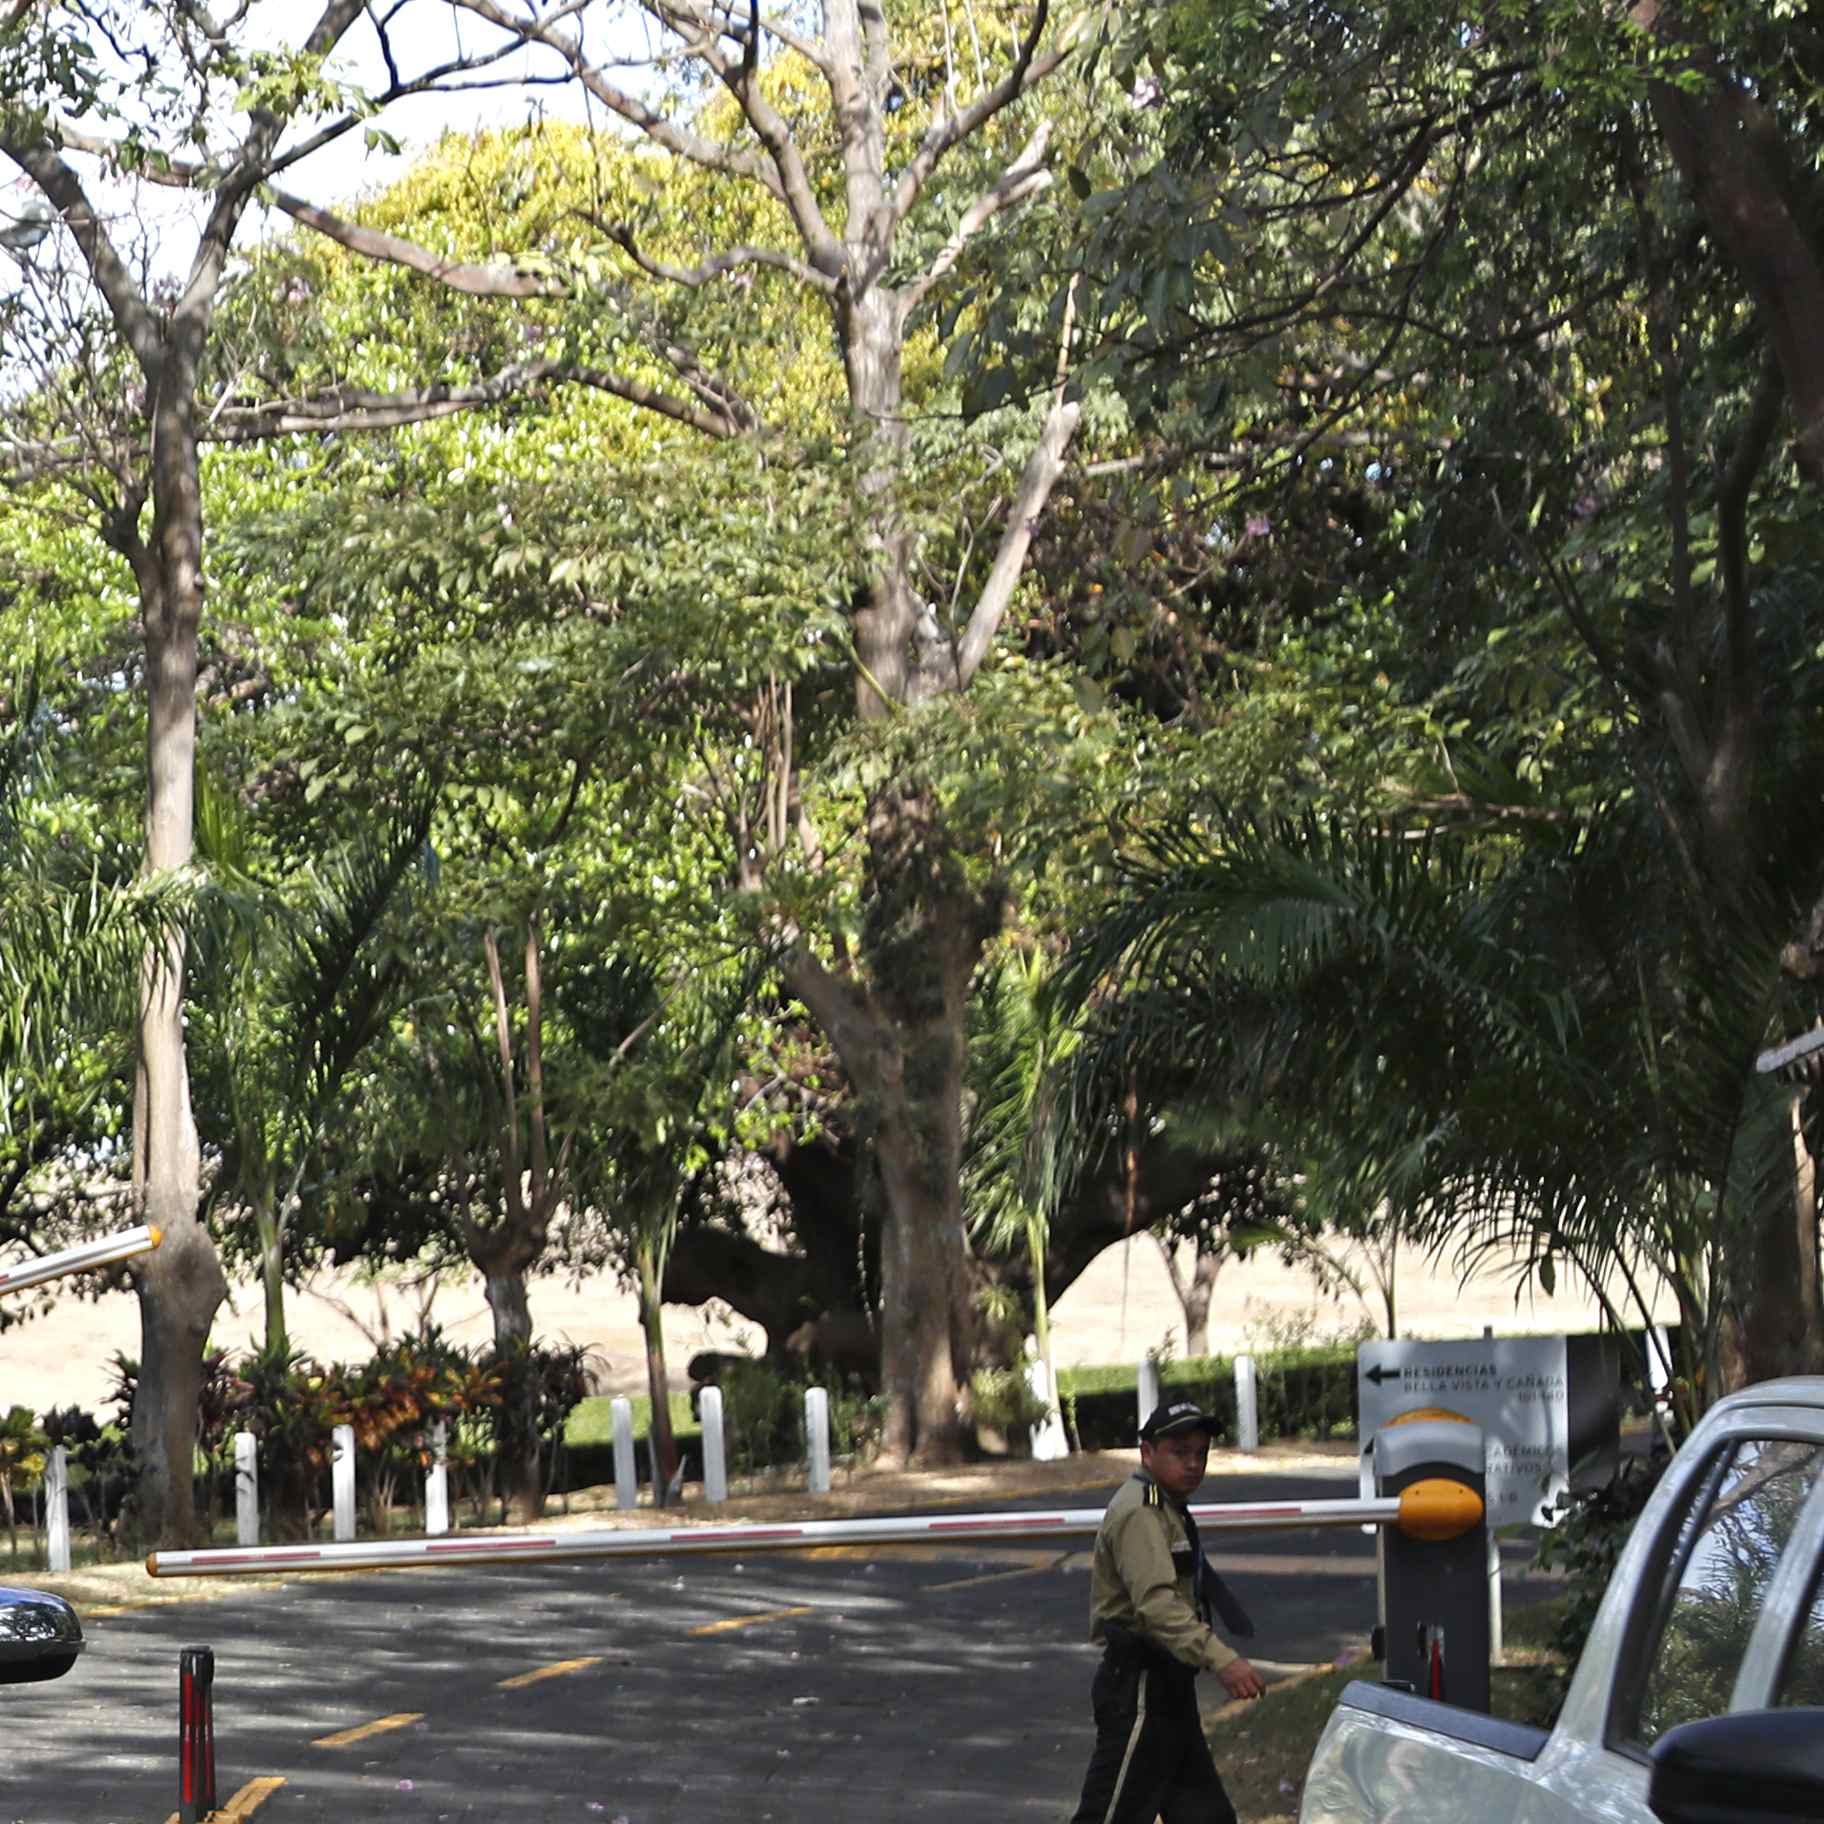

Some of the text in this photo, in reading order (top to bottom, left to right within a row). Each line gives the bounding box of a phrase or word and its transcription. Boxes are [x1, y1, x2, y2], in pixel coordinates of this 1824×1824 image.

[1403, 1364, 1497, 1377] RESIDENCIAS
[1404, 1380, 1448, 1393] BELLA
[1452, 1377, 1489, 1392] VISTA
